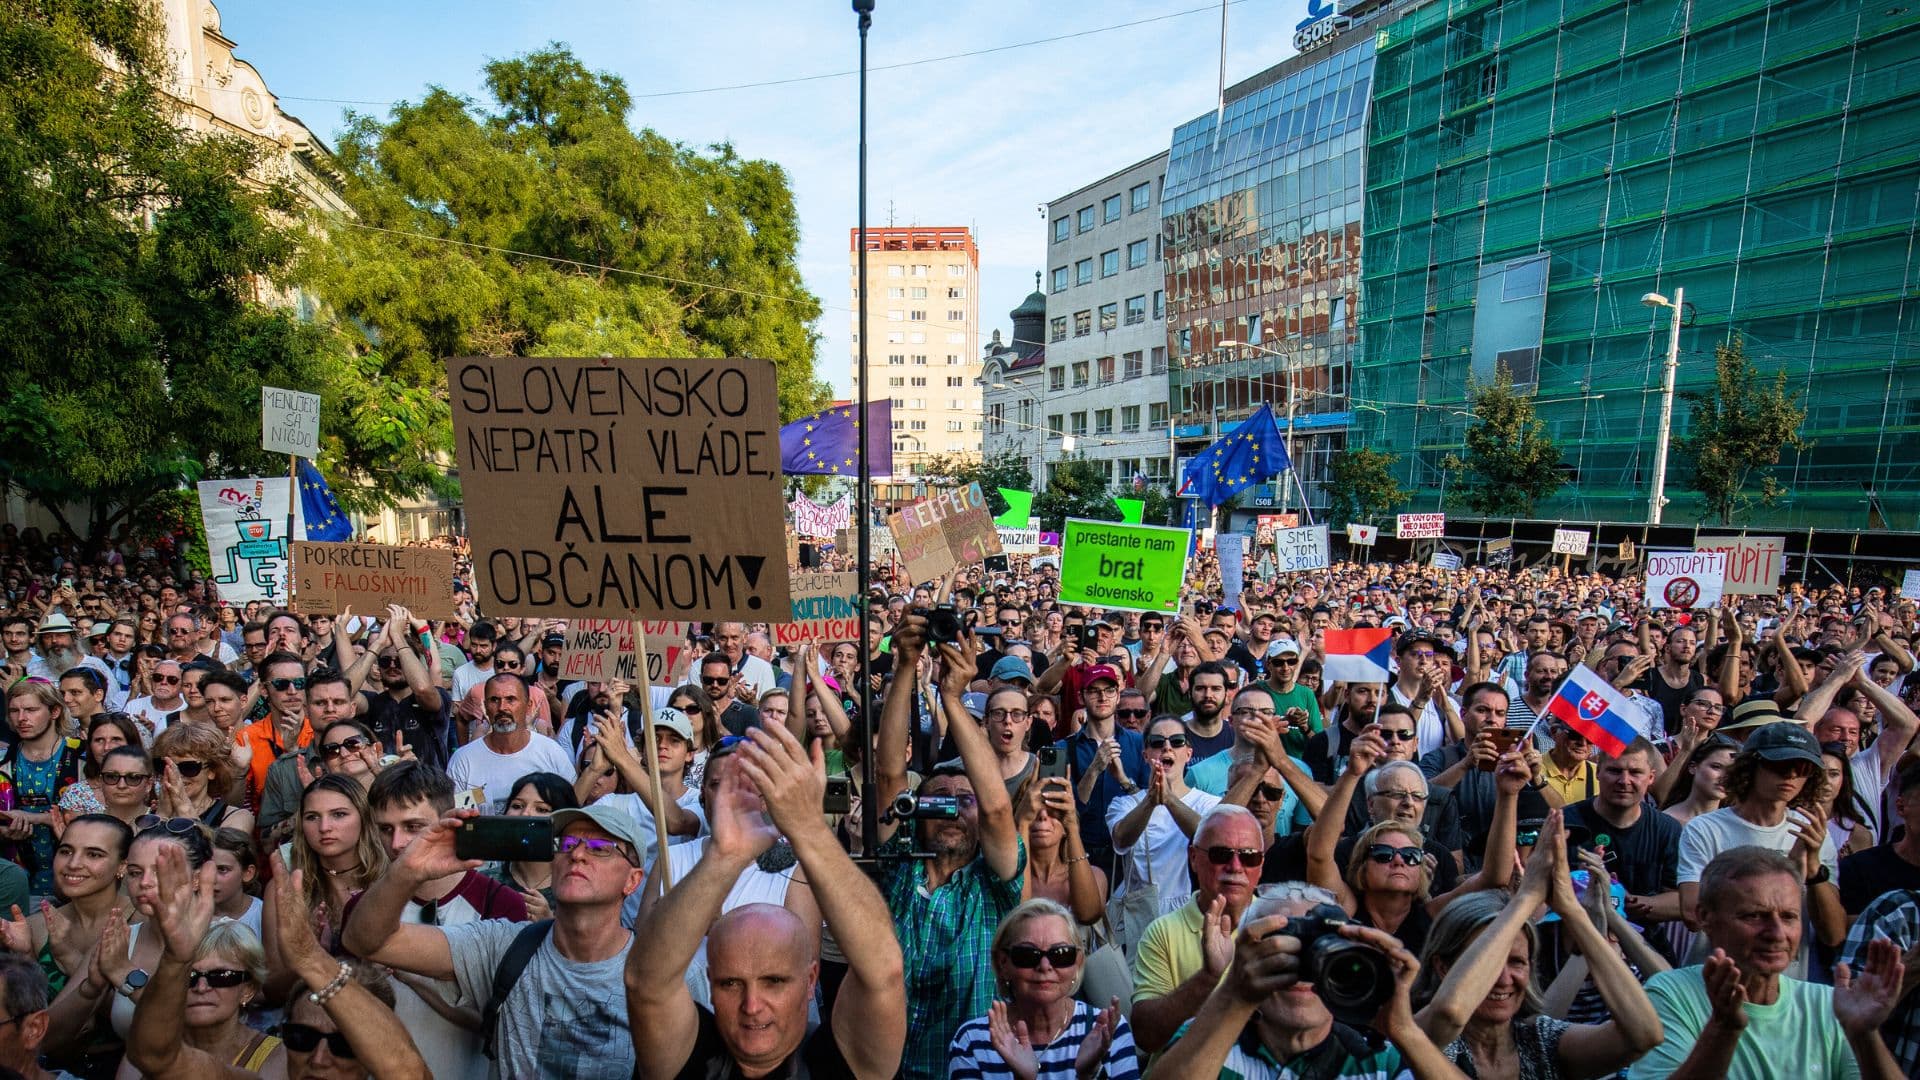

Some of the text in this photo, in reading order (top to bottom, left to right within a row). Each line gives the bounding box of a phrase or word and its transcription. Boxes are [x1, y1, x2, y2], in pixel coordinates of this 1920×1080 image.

[459, 364, 748, 417] SLOVENSKO
[282, 412, 302, 429] SA
[271, 426, 312, 448] NIGDO
[468, 421, 775, 480] NEPATRÍ VLÁDE,
[555, 485, 691, 543] ALE
[1076, 531, 1175, 552] prestante nam
[1286, 529, 1314, 544] SME
[303, 545, 406, 570] POKRČENÉ
[1280, 543, 1317, 557] V TOM
[489, 542, 766, 610] OBČANOM!
[1098, 553, 1145, 581] brat
[1648, 554, 1723, 576] ODSTÚPIŤ!
[324, 571, 428, 595] FALOŠNÝMI
[1085, 583, 1154, 603] slovensko
[574, 630, 611, 650] NAŠEJ
[776, 619, 860, 644] KOALÍCIU
[565, 650, 605, 677] NEMÁ
